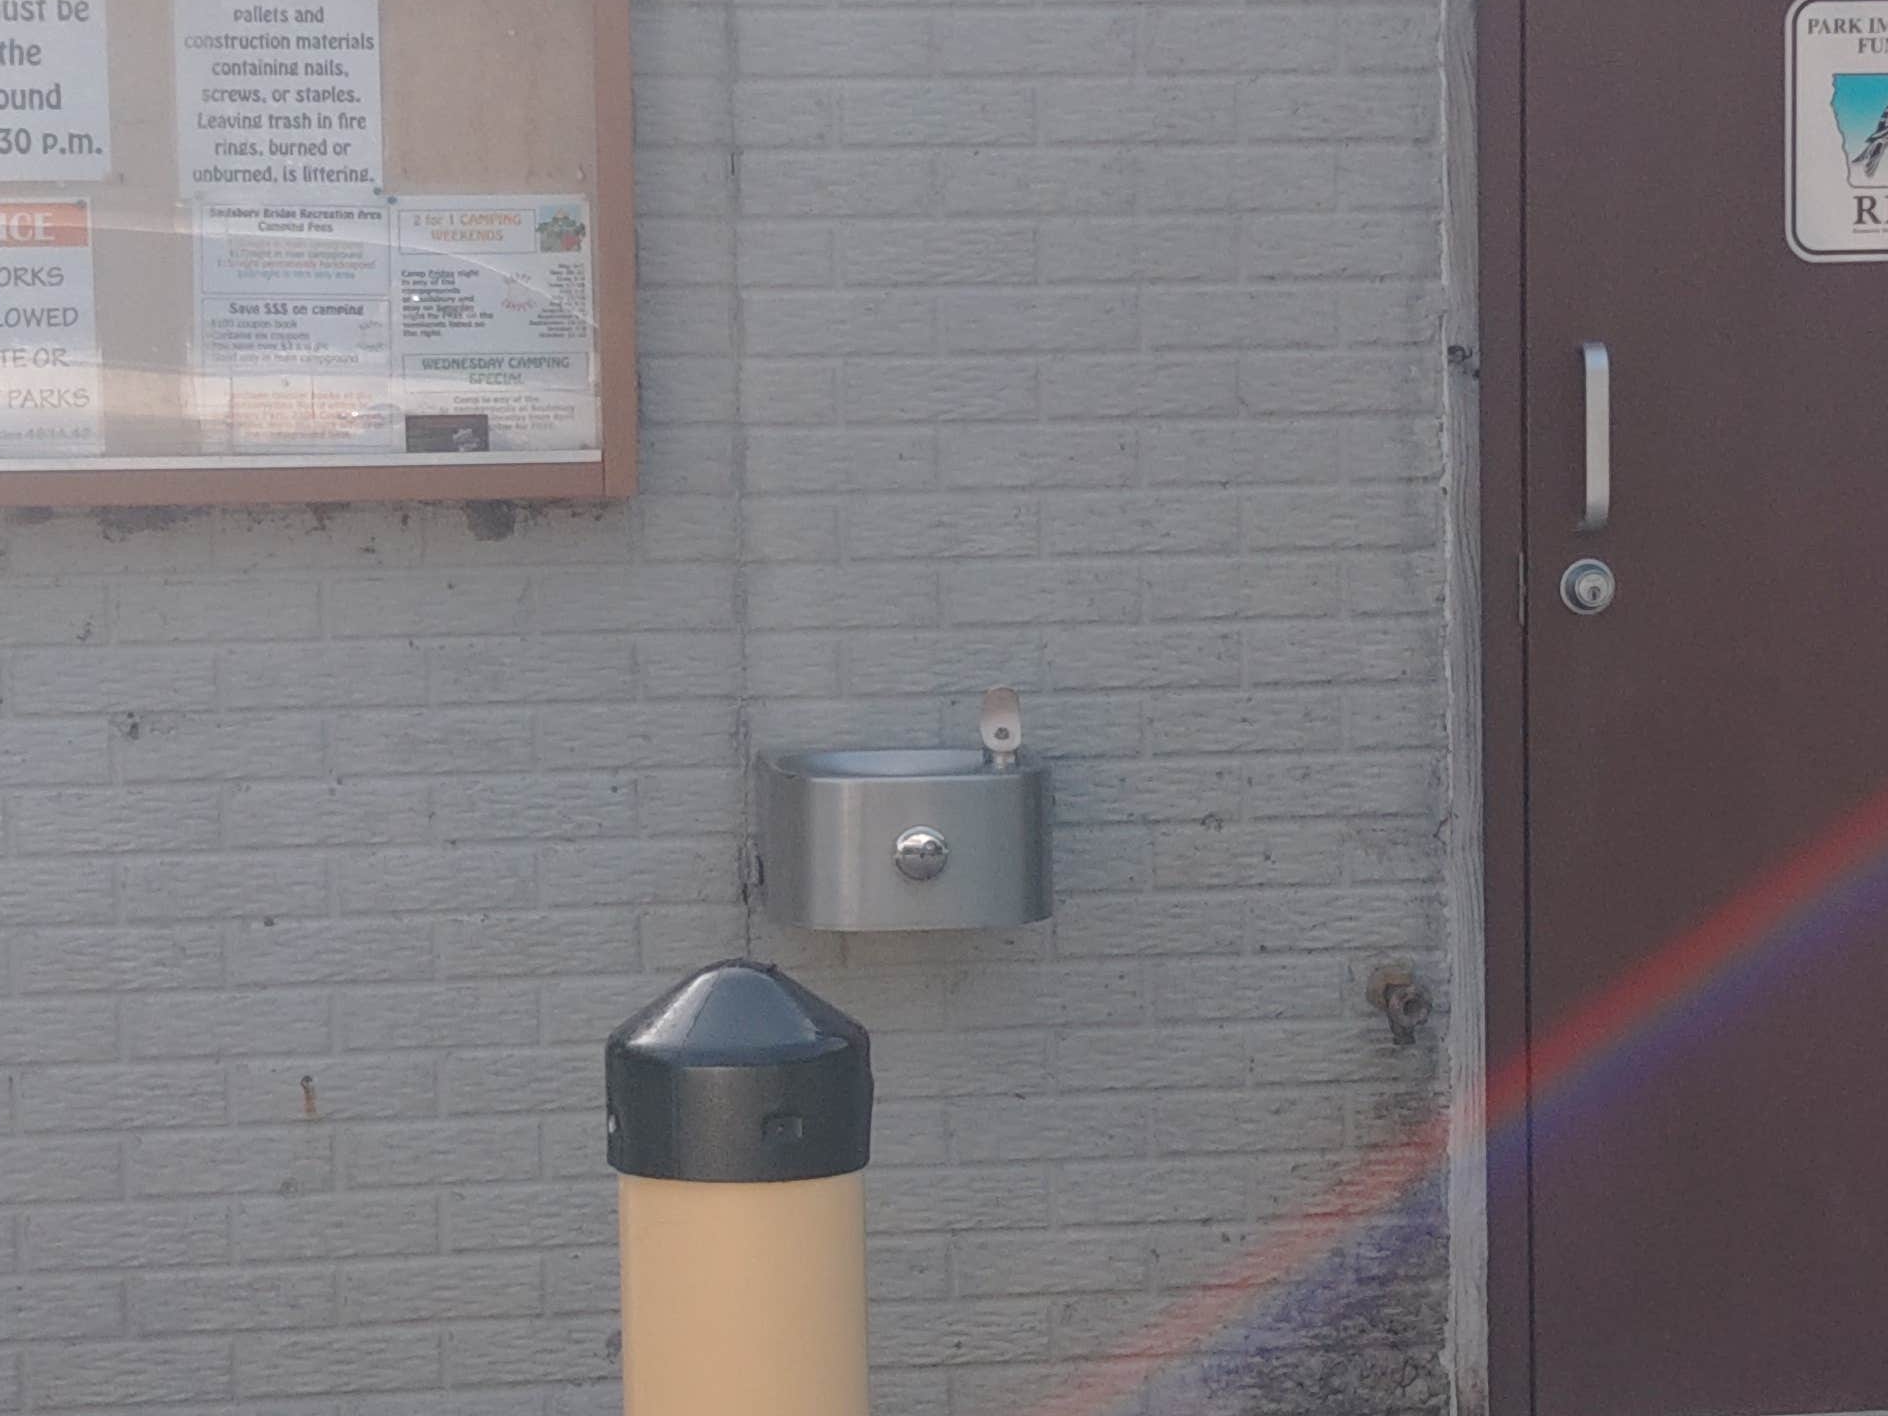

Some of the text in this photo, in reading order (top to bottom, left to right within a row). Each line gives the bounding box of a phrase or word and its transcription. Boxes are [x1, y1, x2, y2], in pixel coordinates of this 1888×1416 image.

[233, 6, 324, 23] pallets and
[1808, 17, 1862, 34] PARK
[184, 33, 374, 50] construction materials
[212, 60, 349, 77] containing nails,
[201, 86, 360, 103] screws, or staples.
[197, 112, 366, 130] Leaving trash in fire
[42, 131, 103, 155] p.m.
[215, 139, 351, 156] rings, burned or
[193, 166, 374, 183] unburned, is littering.
[414, 216, 420, 225] 2
[460, 214, 520, 225] CAMPING
[432, 231, 504, 242] WEEKENDS
[230, 302, 260, 314] Save
[292, 305, 307, 315] on
[312, 304, 364, 316] camping
[33, 348, 70, 368] OR
[422, 356, 570, 370] WEDNESDAY CAMPING
[8, 389, 90, 408] PARKS
